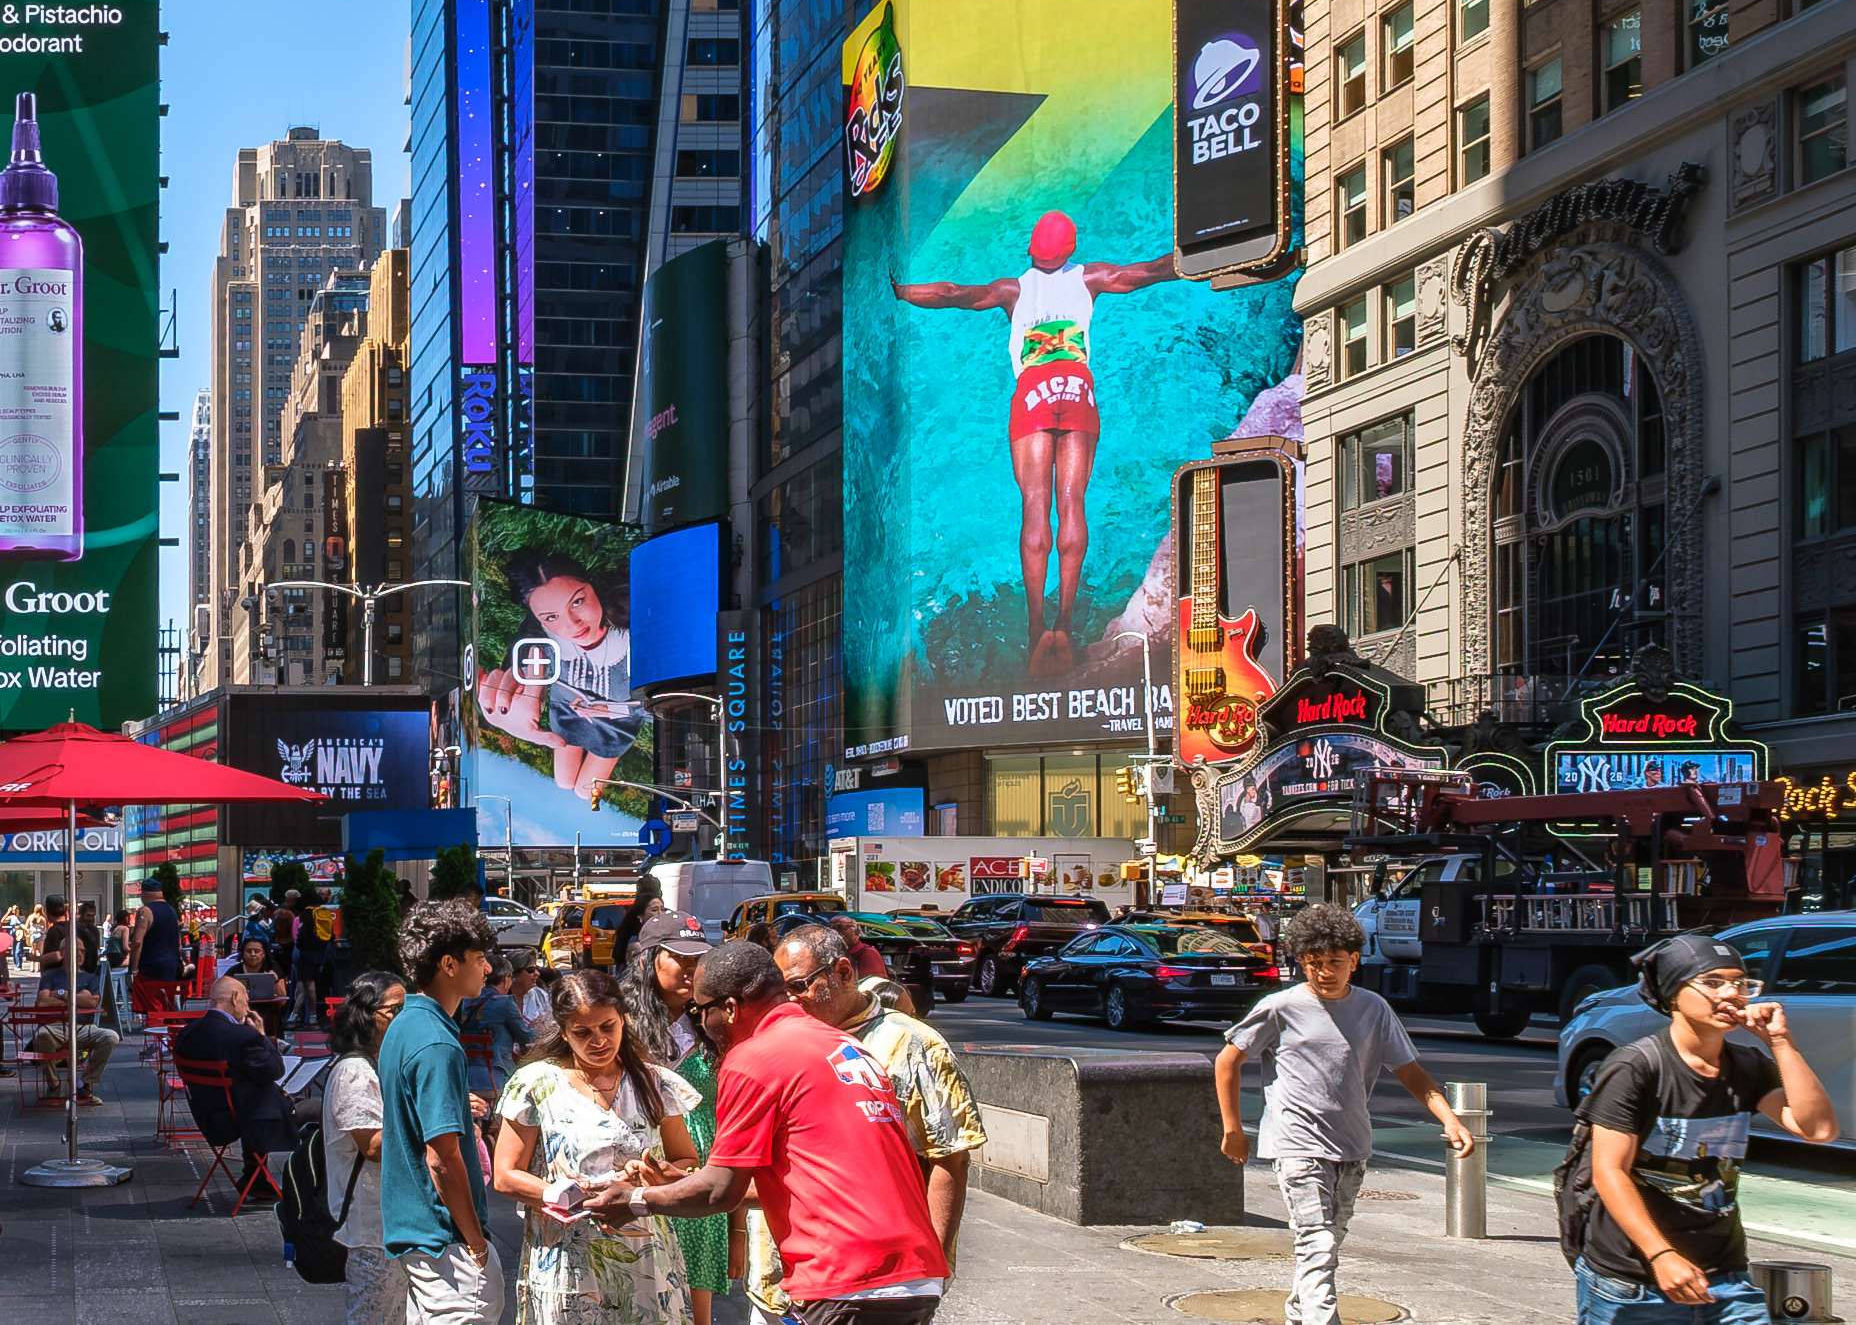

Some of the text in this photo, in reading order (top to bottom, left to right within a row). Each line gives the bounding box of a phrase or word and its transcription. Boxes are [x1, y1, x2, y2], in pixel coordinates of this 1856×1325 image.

[2, 6, 19, 24] &
[25, 4, 123, 24] Pistachio
[1187, 102, 1261, 140] TACO
[1193, 128, 1262, 164] BELL
[14, 276, 67, 295] Groot
[6, 465, 46, 474] PROVEN
[11, 505, 68, 513] EXFOLIATING
[25, 515, 57, 523] WATER
[4, 581, 110, 614] Groot
[27, 667, 102, 689] Water
[729, 631, 746, 733] SQUARE
[944, 697, 1004, 725] VOTED
[1012, 692, 1062, 722] BEST
[1068, 687, 1135, 719] BEACH
[1185, 704, 1229, 726] Hard
[1297, 690, 1367, 724] Hard Rock
[1602, 714, 1697, 737] Hard Rock
[318, 738, 384, 746] AMERICA'S
[1313, 739, 1333, 779] NY
[834, 767, 864, 791] AT&T
[1564, 755, 1623, 794] 20 NY 26
[321, 787, 334, 798] BY
[340, 787, 361, 798] THE
[366, 787, 387, 799] SEA
[729, 759, 746, 835] TIMES
[1327, 780, 1339, 792] FOR
[1, 832, 62, 852] YORK
[972, 860, 1020, 875] ACE
[972, 879, 1022, 895] ENDICO
